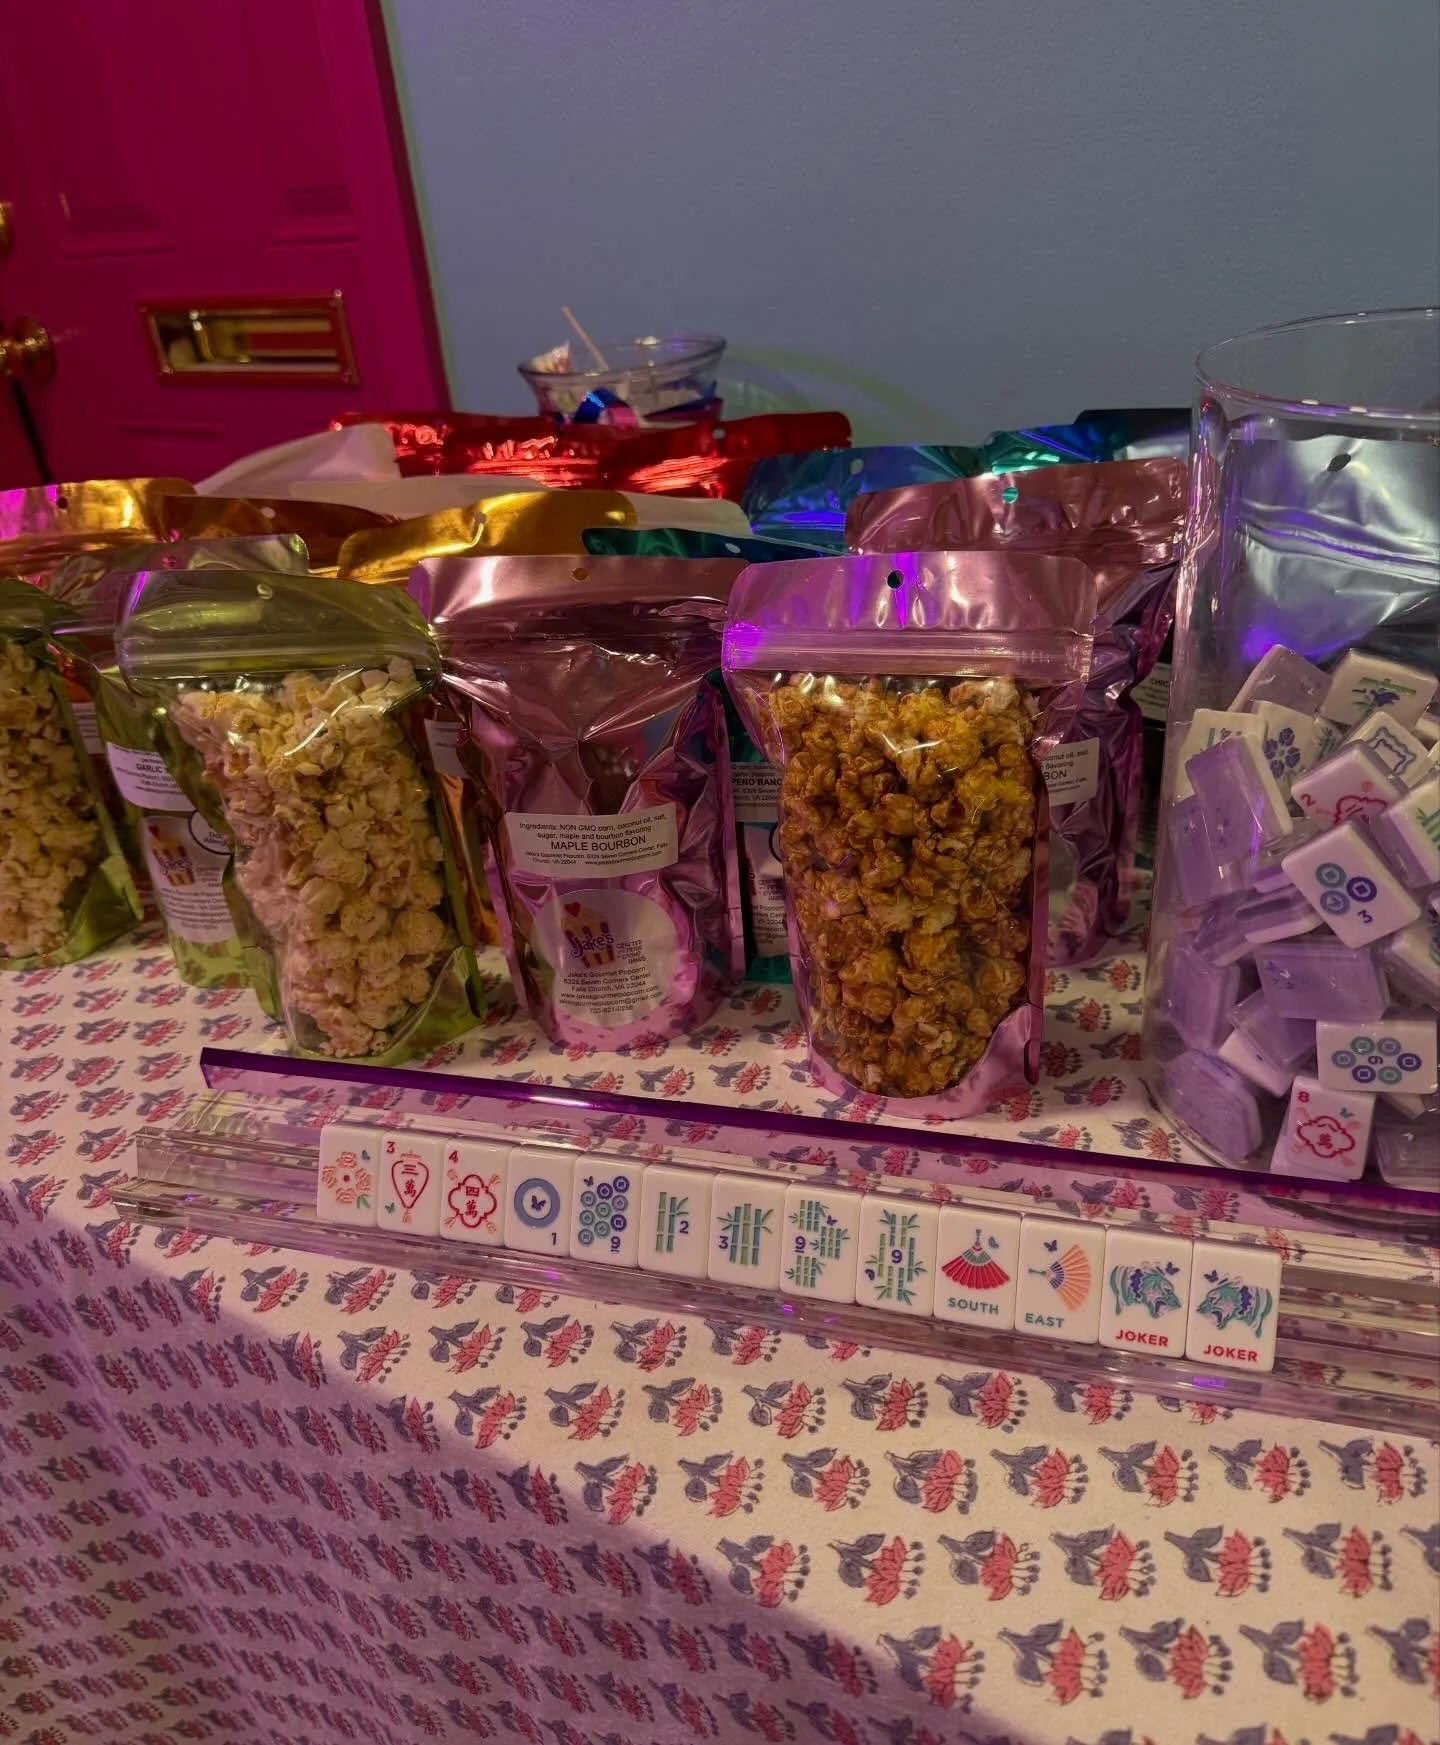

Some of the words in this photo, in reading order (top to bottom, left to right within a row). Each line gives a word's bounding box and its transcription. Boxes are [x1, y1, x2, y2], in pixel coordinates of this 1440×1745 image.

[136, 763, 163, 773] GARLIC
[1301, 793, 1316, 807] 2
[520, 823, 557, 831] Ingredients:
[578, 824, 597, 832] GMO
[617, 819, 642, 829] coconut
[559, 832, 580, 840] maple
[581, 832, 594, 840] and
[595, 831, 624, 840] bourbon
[624, 825, 652, 836] flavoring
[551, 841, 588, 851] MAPLE
[591, 835, 646, 852] BOURBON
[1357, 909, 1373, 924] 3
[571, 933, 614, 958] Jake's
[1298, 1090, 1310, 1103] 8
[387, 1141, 396, 1154] 3
[449, 1150, 459, 1163] 4
[679, 1220, 689, 1234] 2
[551, 1232, 557, 1246] 1
[610, 1236, 621, 1250] 9
[719, 1236, 729, 1249] 3
[795, 1236, 806, 1250] 9
[891, 1249, 902, 1264] 9
[948, 1297, 999, 1314] SOUTH
[1025, 1312, 1065, 1328] EAST
[1115, 1330, 1169, 1347] JOKER
[1204, 1344, 1258, 1362] JOKER
